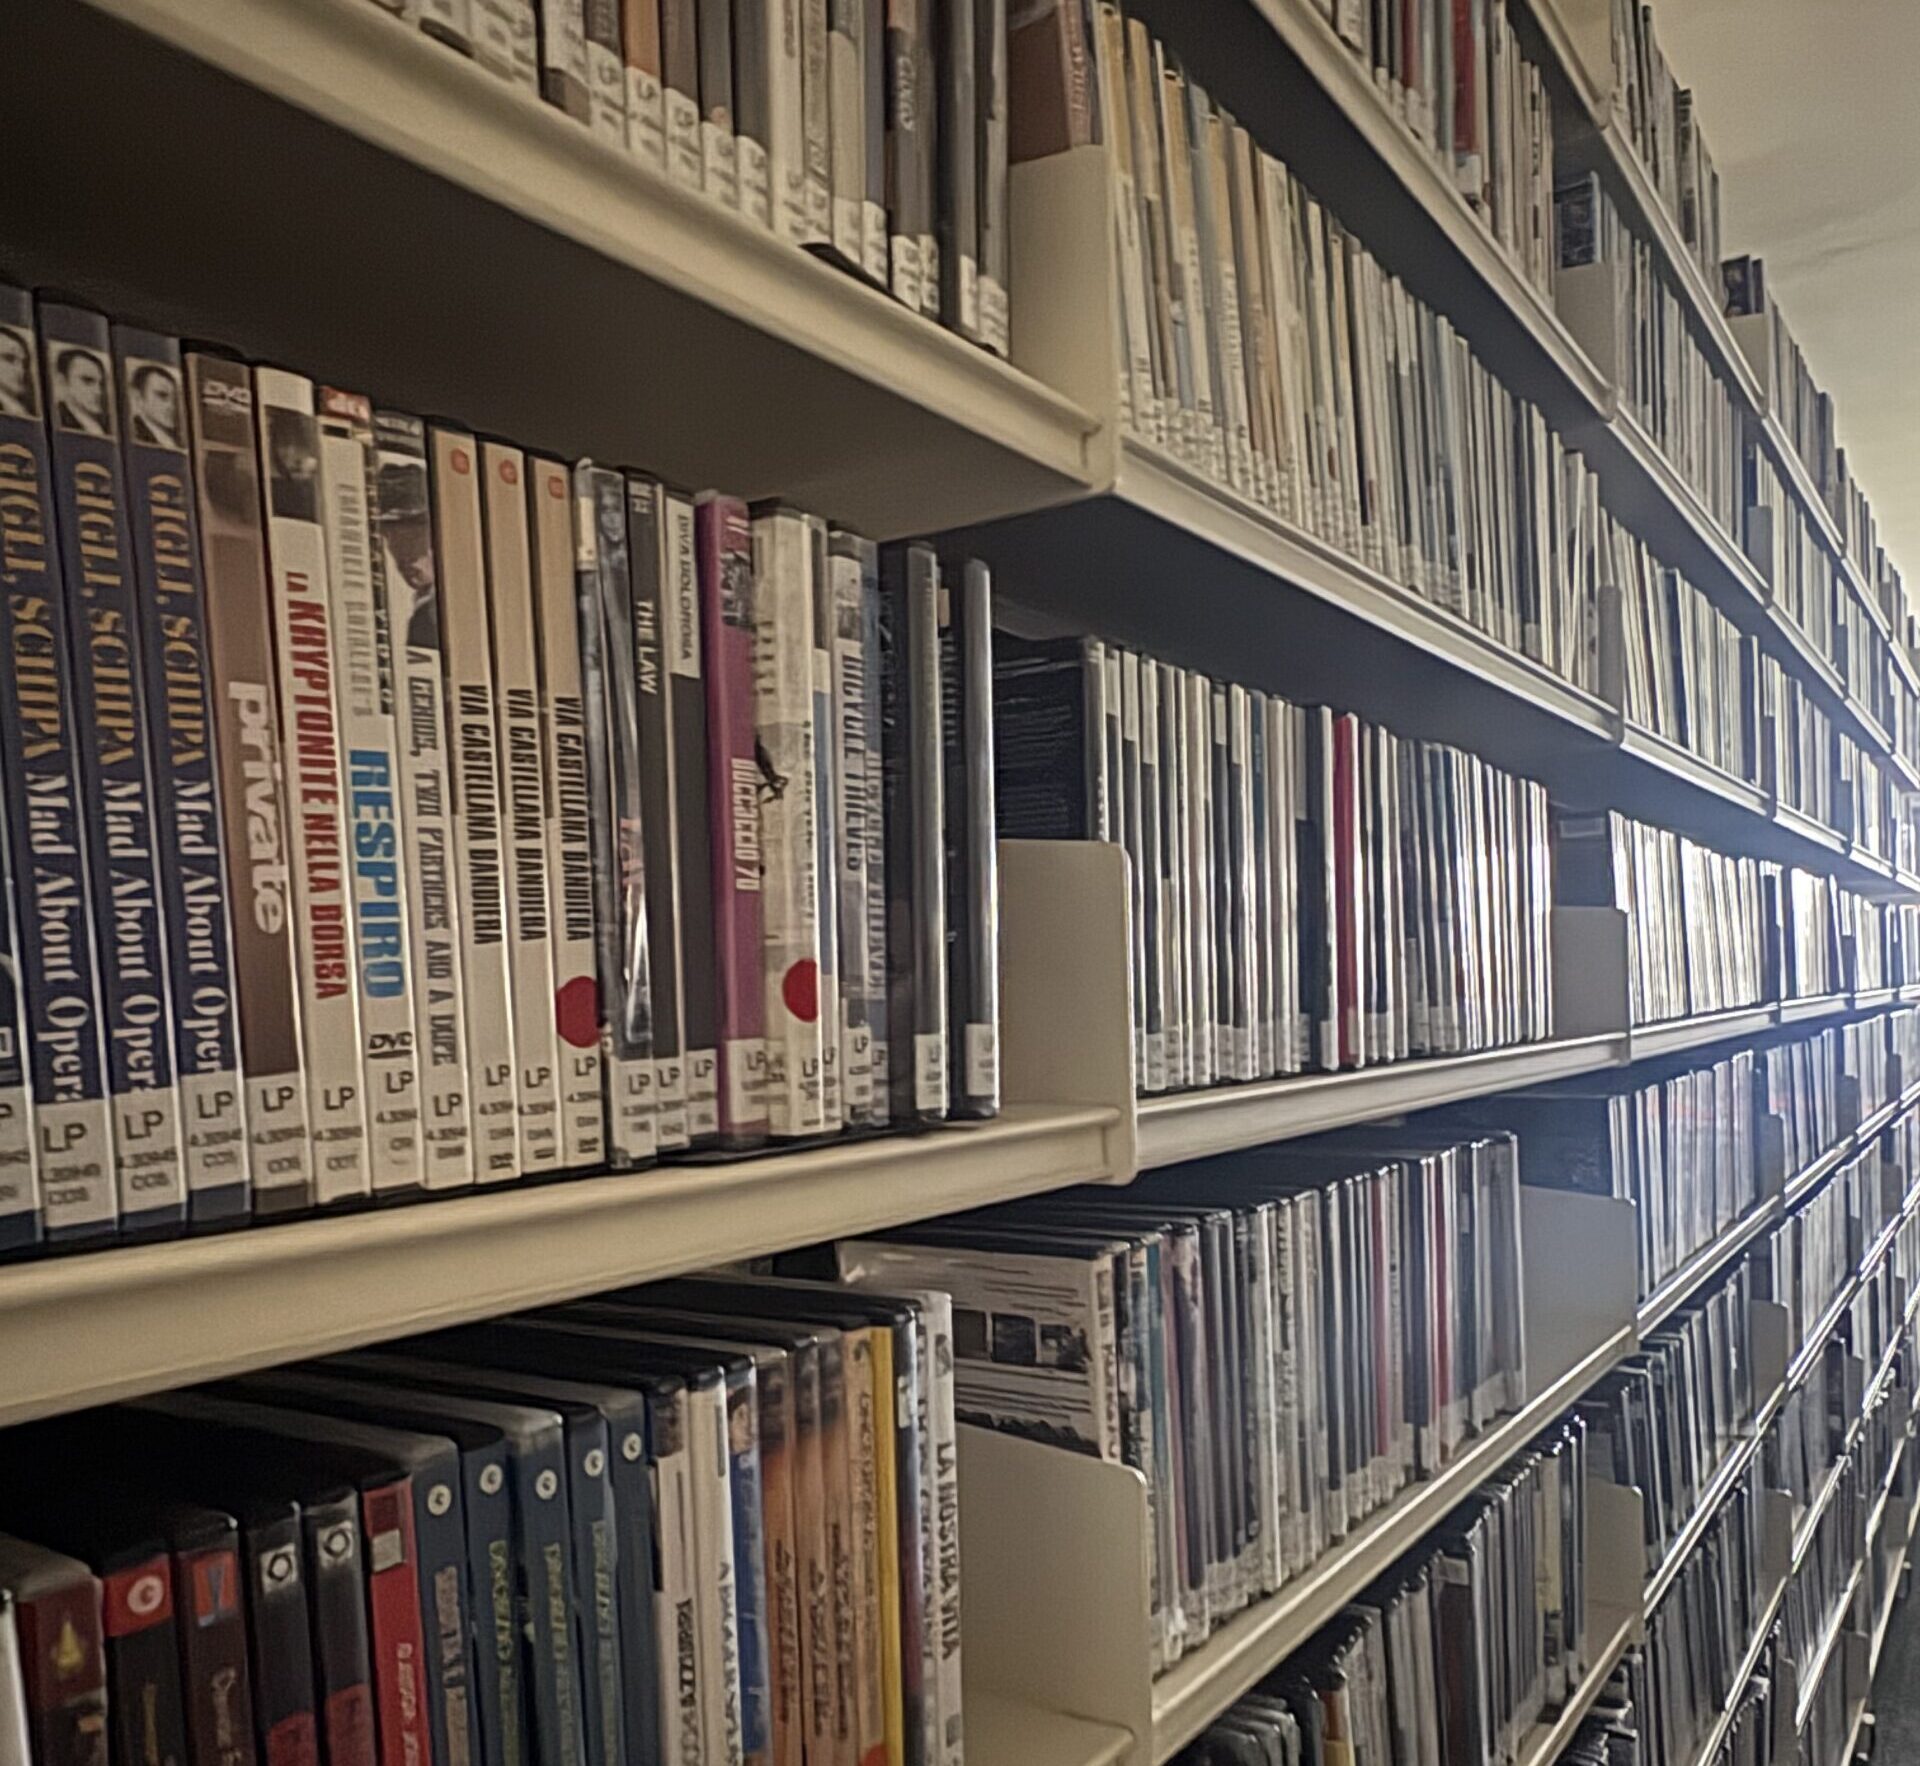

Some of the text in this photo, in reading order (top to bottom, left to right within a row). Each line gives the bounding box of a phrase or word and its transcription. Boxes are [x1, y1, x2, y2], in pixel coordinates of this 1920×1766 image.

[406, 650, 432, 664] A
[635, 601, 658, 695] THE LAW
[287, 600, 337, 808] KRYPTONITE
[25, 772, 77, 856] Mad
[172, 777, 217, 856] Mad
[228, 681, 290, 934] private
[414, 769, 443, 817] TWO
[459, 685, 502, 944] VIA CASTELLANA BANDIERA
[507, 689, 546, 941] VIA CASTELLANA BANDIERA
[101, 778, 149, 859] Mad
[554, 697, 591, 941] VIA CASTELLANA BANDIERA
[304, 813, 341, 893] NELLA
[349, 749, 404, 998] RESPIRO
[417, 827, 449, 931] PARTNERS
[35, 867, 82, 982] About
[109, 869, 154, 981] About
[180, 866, 221, 974] About
[310, 904, 348, 999] BORSA
[425, 940, 451, 980] AND
[429, 989, 454, 1005] A
[430, 1014, 457, 1065] DUPE
[854, 1035, 869, 1053] LP
[386, 1070, 413, 1094] LP
[486, 1064, 511, 1087] LP
[525, 1067, 551, 1088] LP
[575, 1056, 597, 1077] LP
[629, 1073, 650, 1095] LP
[658, 1066, 680, 1088] LP
[695, 1059, 714, 1078] LP
[197, 1090, 233, 1119] LP
[262, 1086, 294, 1113] LP
[324, 1087, 355, 1111] LP
[434, 1093, 463, 1117] LP
[43, 1122, 87, 1153] LP
[124, 1110, 164, 1140] LP
